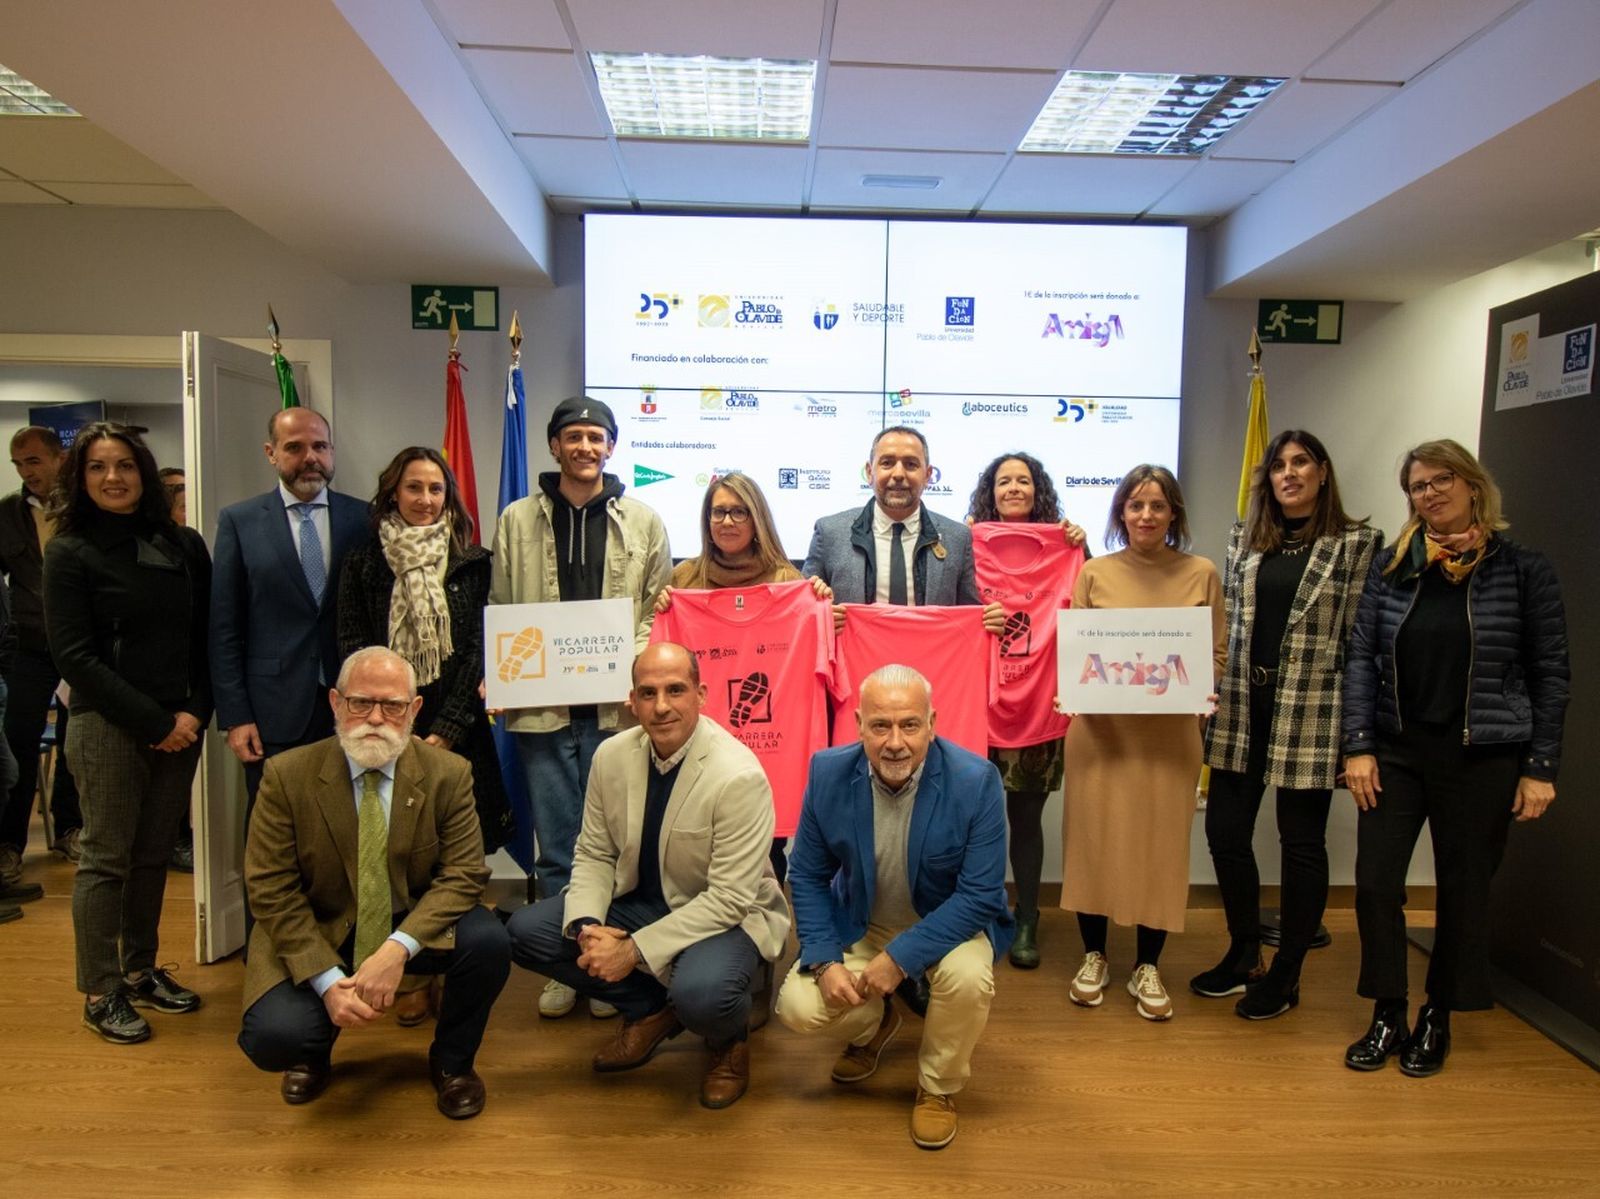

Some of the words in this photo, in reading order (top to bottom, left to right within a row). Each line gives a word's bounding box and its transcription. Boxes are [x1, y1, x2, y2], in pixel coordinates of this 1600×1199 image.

[1034, 290, 1043, 298] de
[1052, 291, 1088, 300] inscripción
[1106, 292, 1132, 300] donado
[853, 302, 904, 312] SALUDABLE
[853, 314, 858, 322] Y
[862, 313, 904, 323] DEPORTE
[631, 353, 678, 363] Financiado
[680, 356, 691, 364] en
[692, 354, 749, 364] colaboración
[808, 404, 837, 412] metro
[967, 402, 1028, 413] laboceutics
[631, 440, 664, 448] Entidades
[666, 441, 718, 450] colaboradoras:
[1066, 476, 1090, 484] Diario
[1087, 630, 1096, 638] de
[1097, 630, 1104, 638] la
[1104, 630, 1140, 638] inscripción
[1157, 630, 1184, 638] donado
[564, 636, 624, 646] CARRERA
[559, 644, 619, 656] POPULAR
